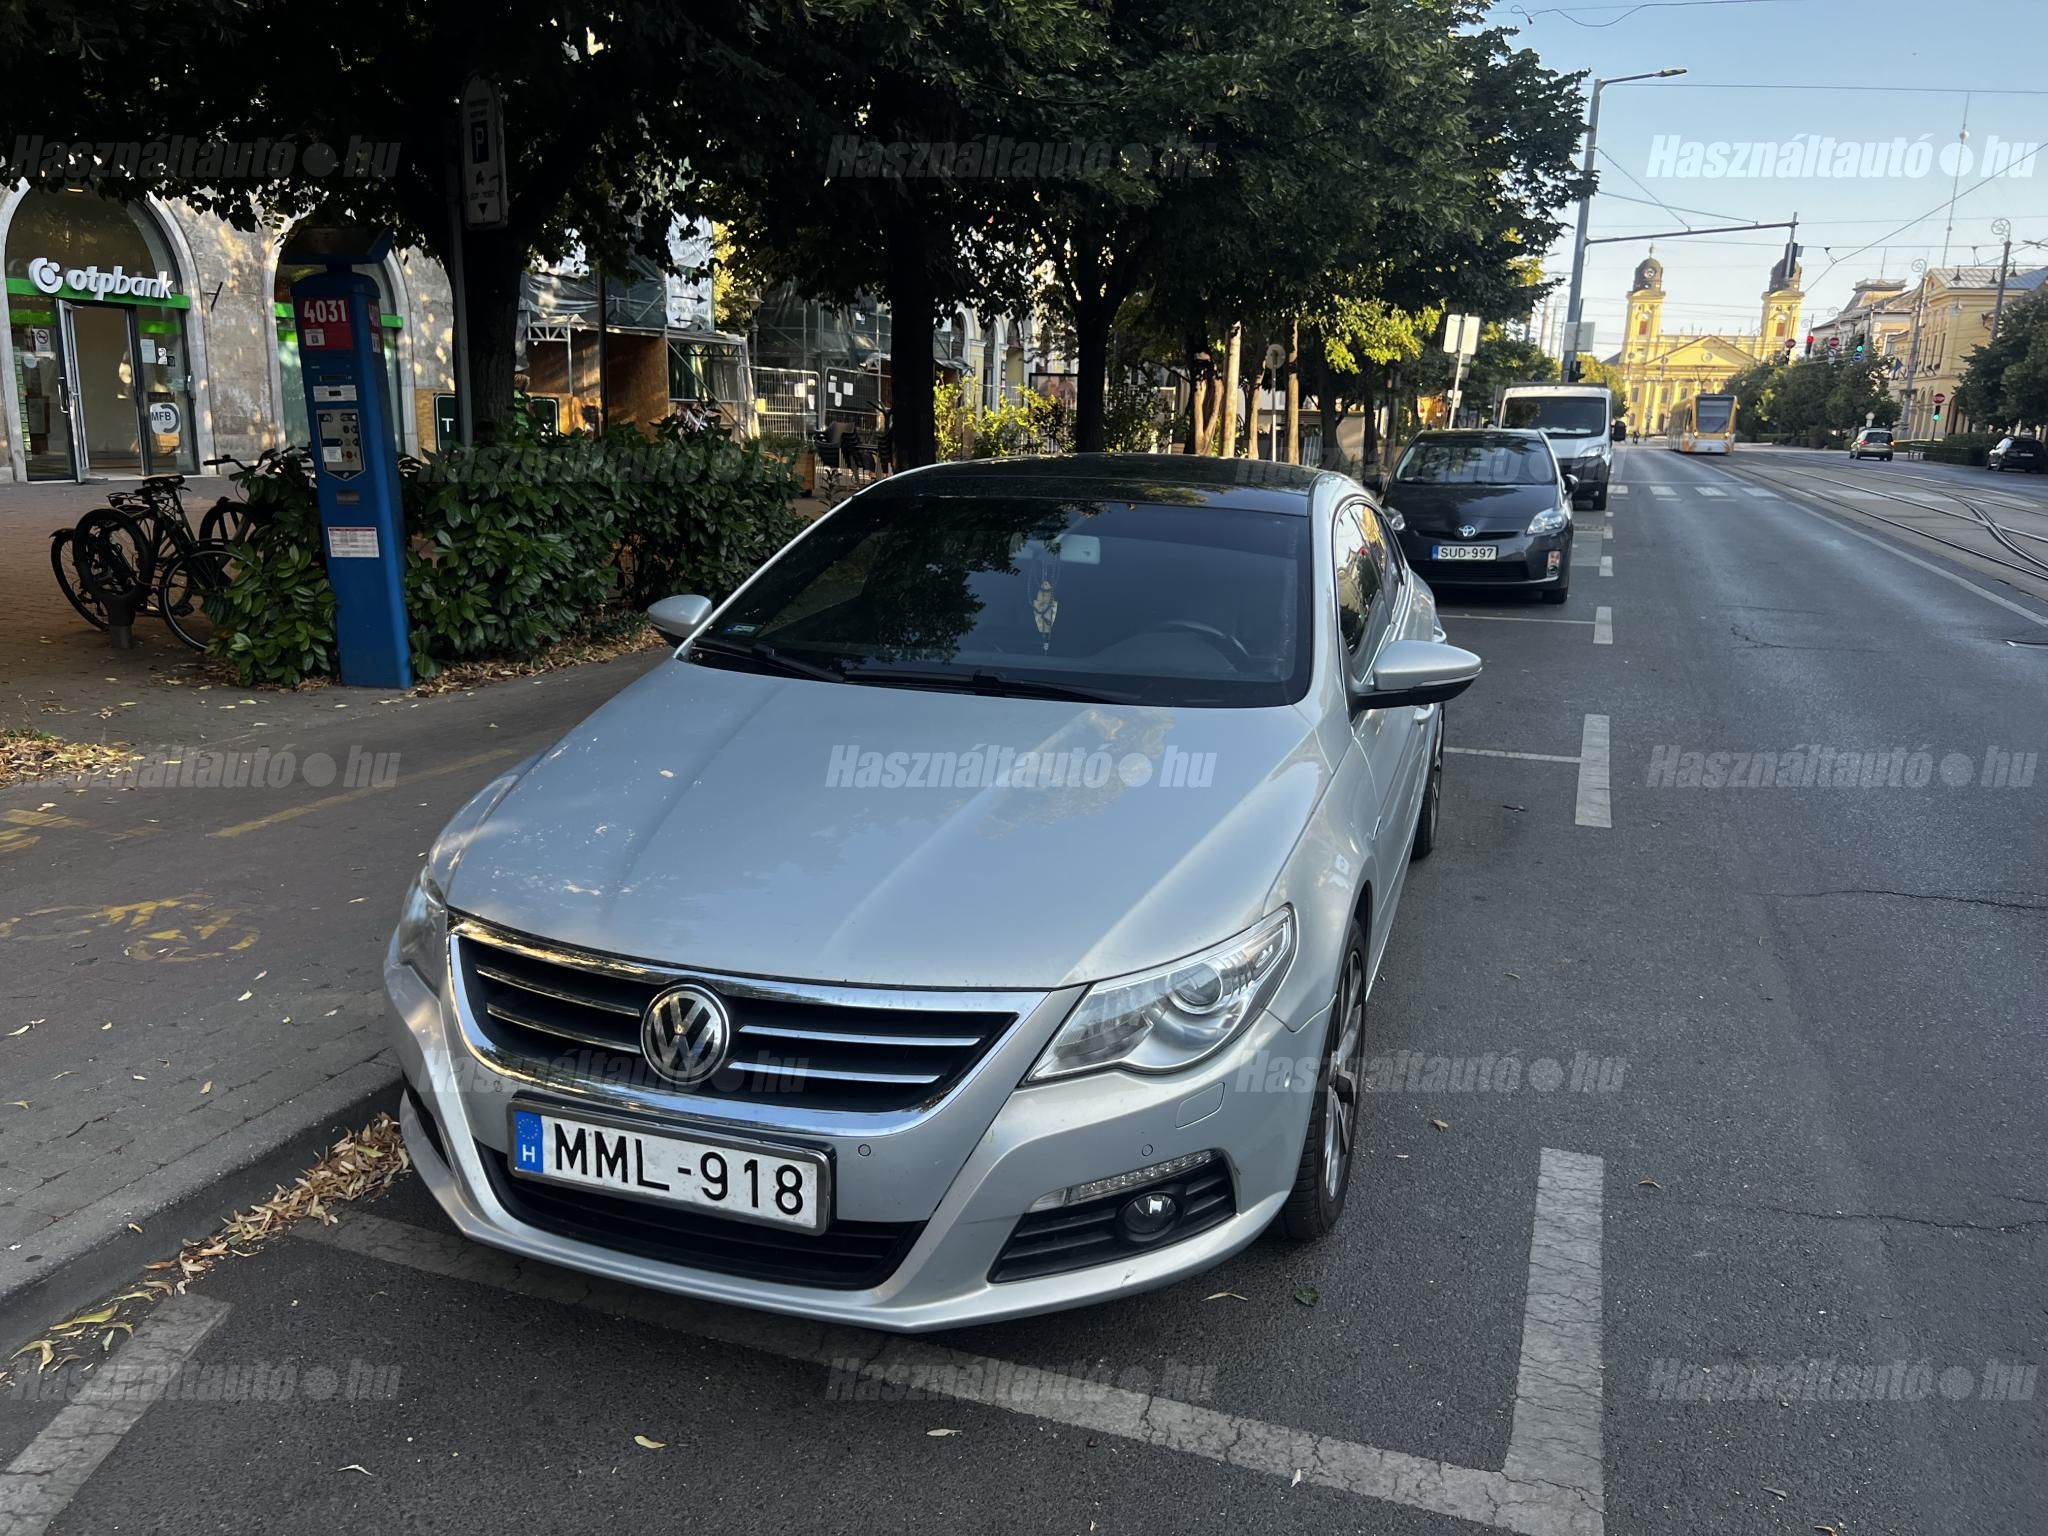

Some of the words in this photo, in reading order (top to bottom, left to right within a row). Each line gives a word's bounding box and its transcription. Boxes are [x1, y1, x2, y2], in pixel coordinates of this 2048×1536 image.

[66, 265, 174, 301] otpbank
[303, 299, 348, 324] 4031
[151, 411, 172, 422] MFB
[1440, 547, 1494, 558] SUD-997
[522, 1145, 536, 1165] H
[553, 1122, 804, 1216] MML-918
